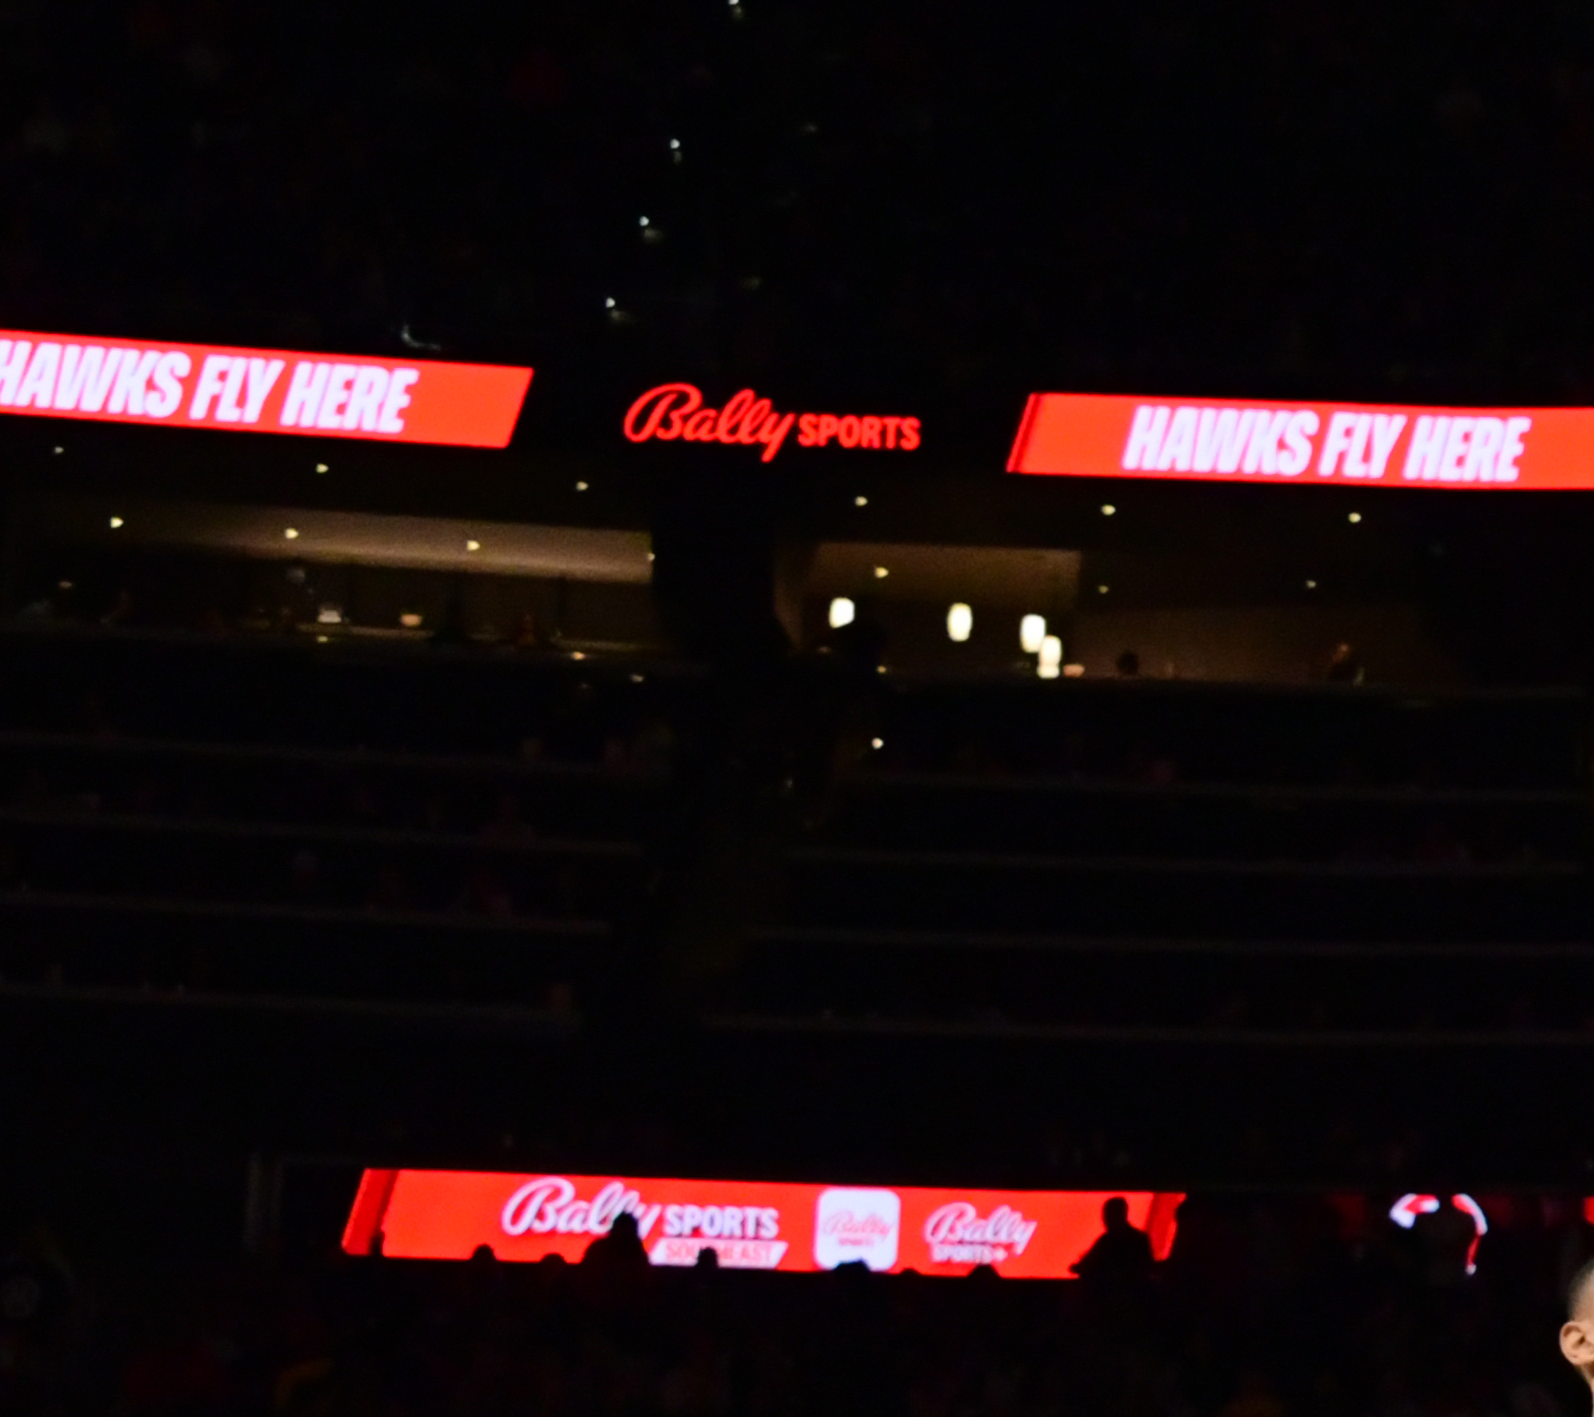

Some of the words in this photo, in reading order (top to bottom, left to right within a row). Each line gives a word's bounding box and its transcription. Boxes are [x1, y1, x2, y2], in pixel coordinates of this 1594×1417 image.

[0, 339, 192, 418] HAWKS
[189, 354, 286, 425] FLY
[280, 361, 421, 434] HERE
[622, 382, 796, 463] Bally
[799, 411, 921, 450] SPORTS
[1121, 403, 1321, 477] HAWKS
[1317, 412, 1405, 477] FLY
[1402, 416, 1533, 483] HERE
[663, 1205, 779, 1240] SPORTS
[924, 1202, 1037, 1251] Bally
